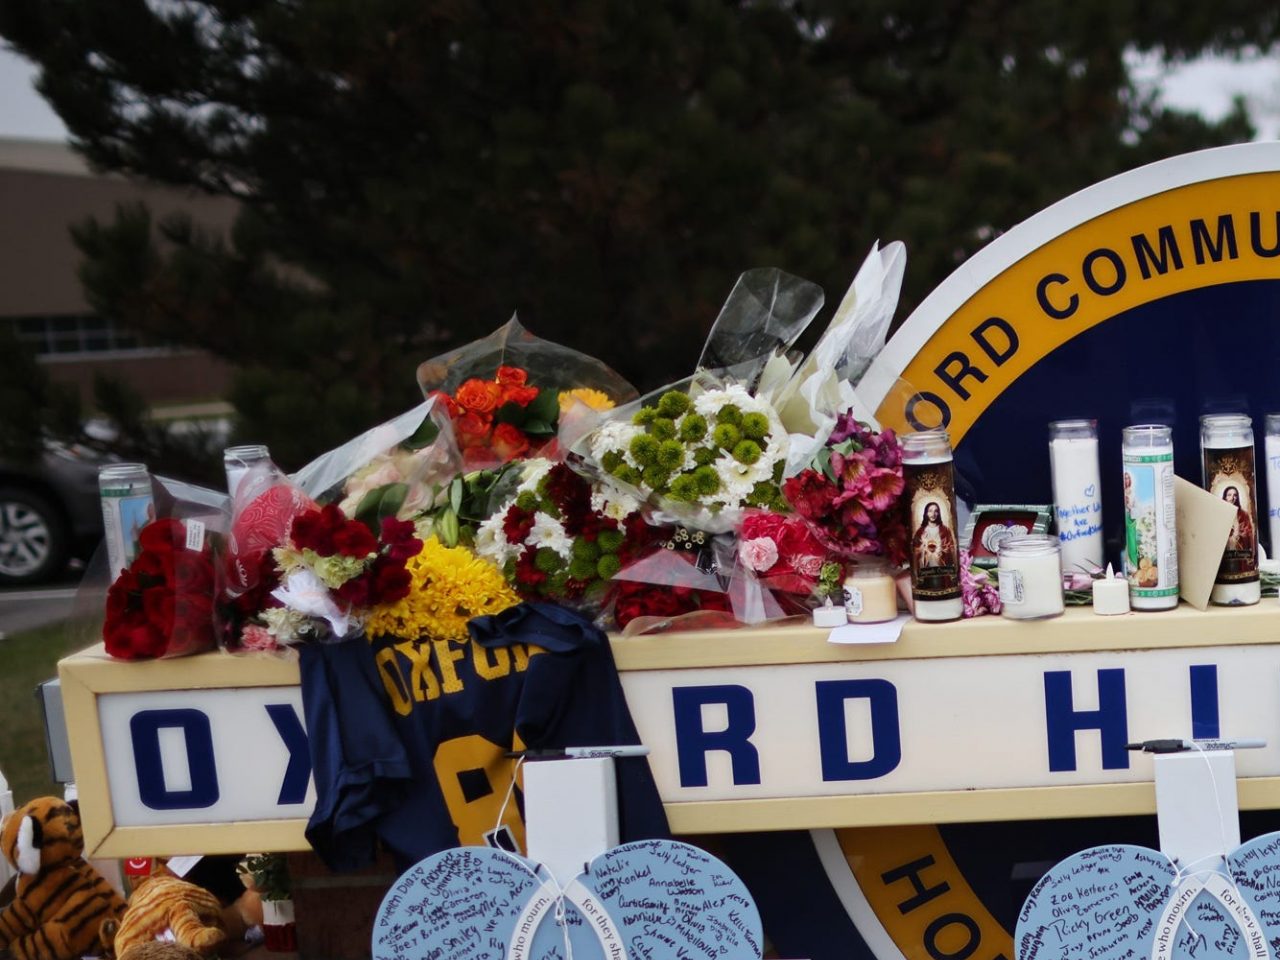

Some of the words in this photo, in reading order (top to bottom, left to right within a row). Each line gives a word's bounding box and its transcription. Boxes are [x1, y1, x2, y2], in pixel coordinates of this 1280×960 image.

[904, 316, 1022, 433] ORD
[376, 636, 549, 717] OXFO
[130, 678, 902, 811] OXRD
[513, 936, 526, 960] who
[581, 898, 598, 915] for
[597, 915, 614, 941] they
[1157, 924, 1171, 953] who
[1220, 888, 1237, 906] for
[1251, 930, 1268, 957] shall
